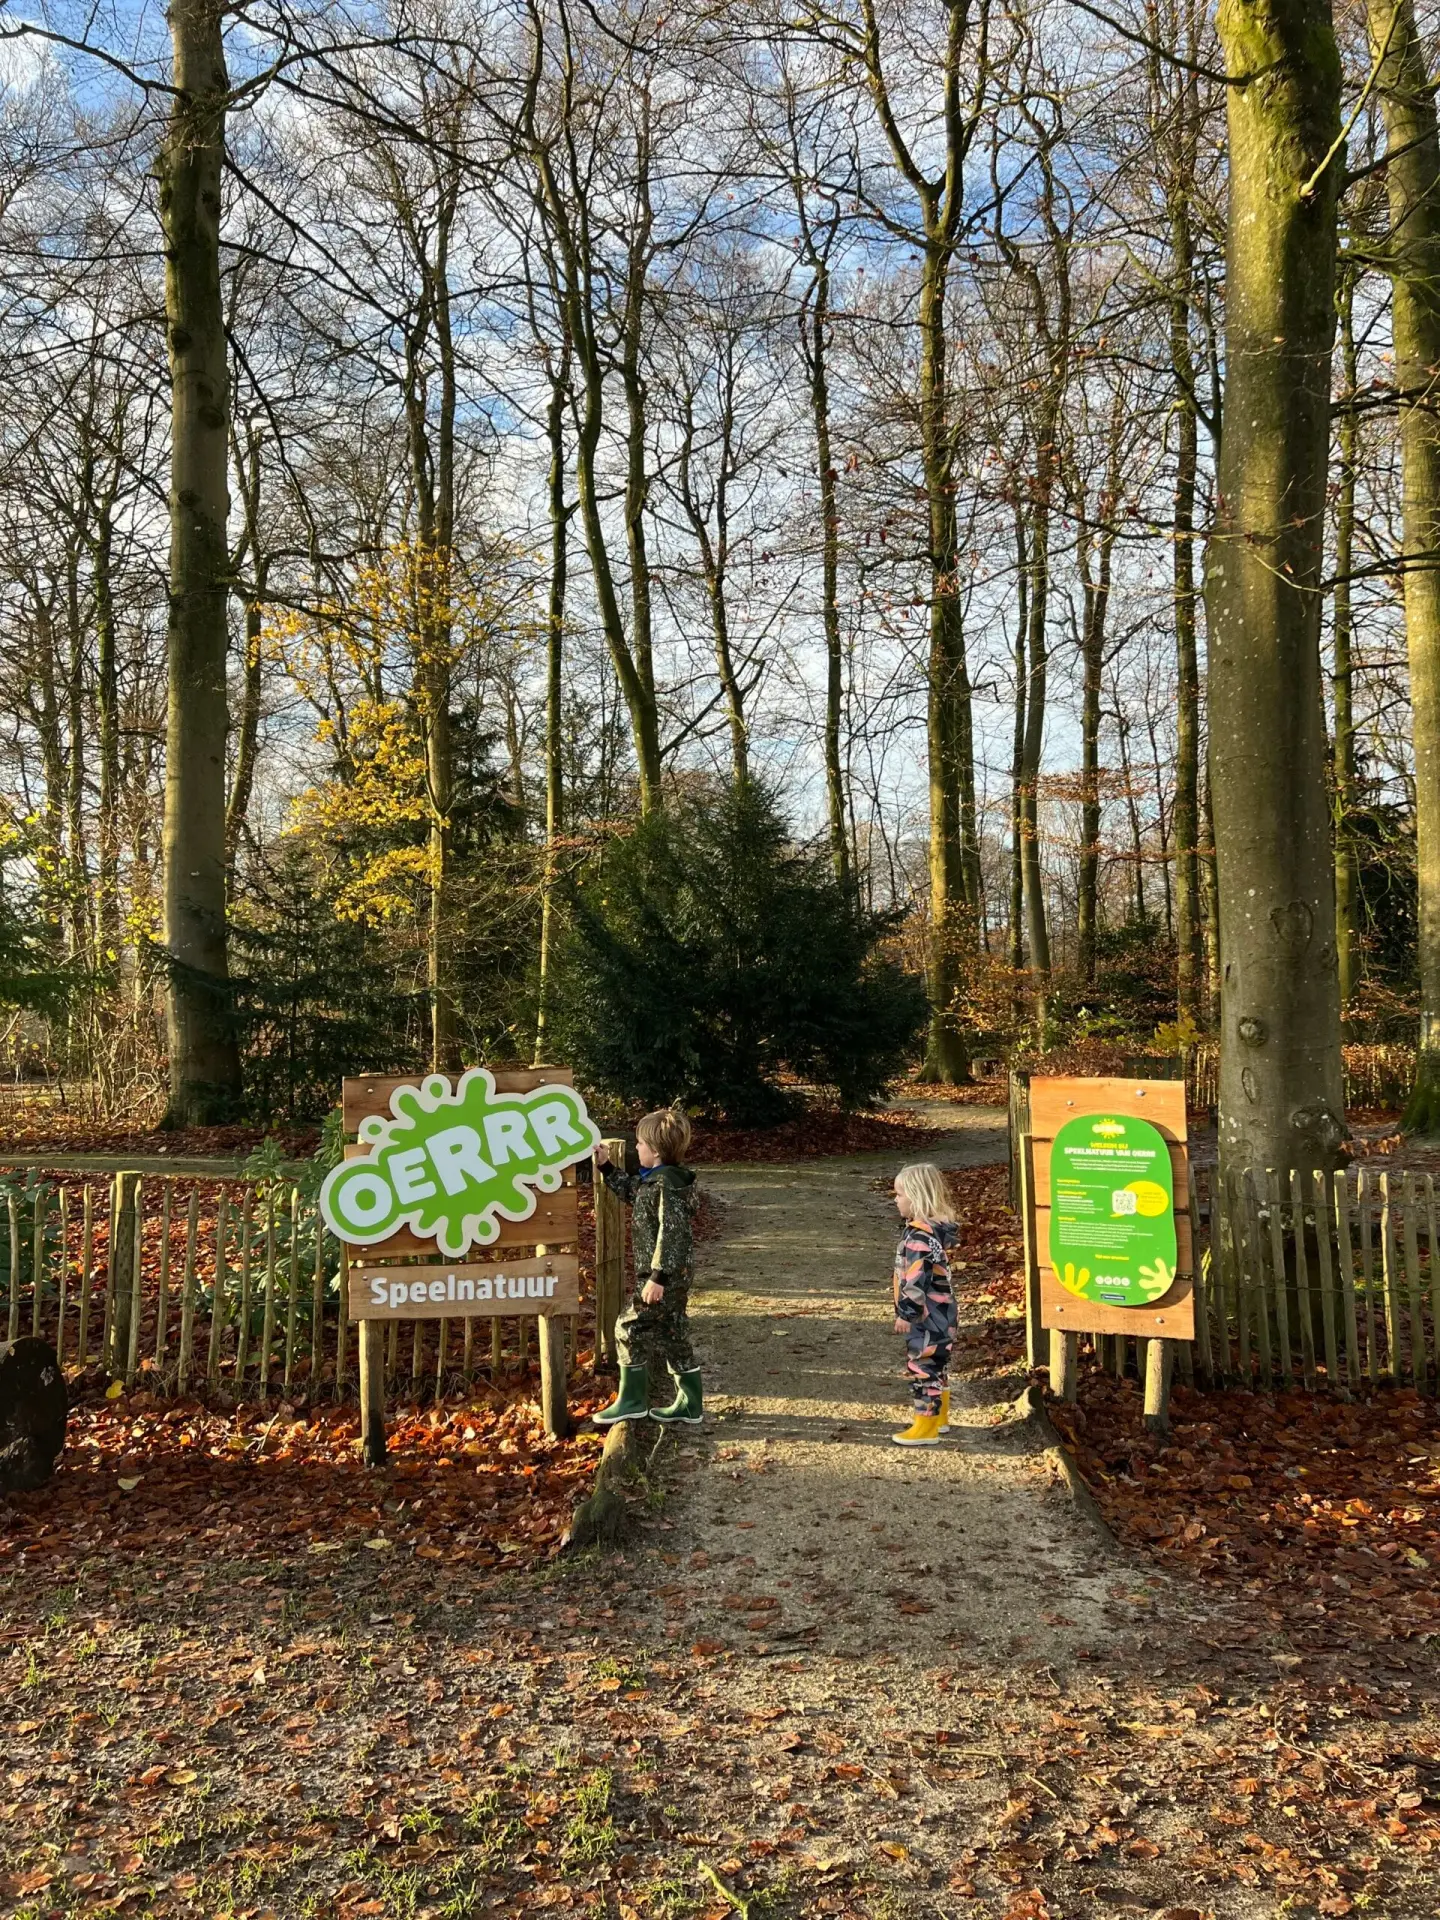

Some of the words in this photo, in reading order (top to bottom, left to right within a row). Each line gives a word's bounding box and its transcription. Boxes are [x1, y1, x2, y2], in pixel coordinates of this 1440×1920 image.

[338, 1101, 585, 1227] OERRR
[1064, 1147, 1114, 1156] SPEELNATUUR
[370, 1274, 559, 1308] Speelnatuur
